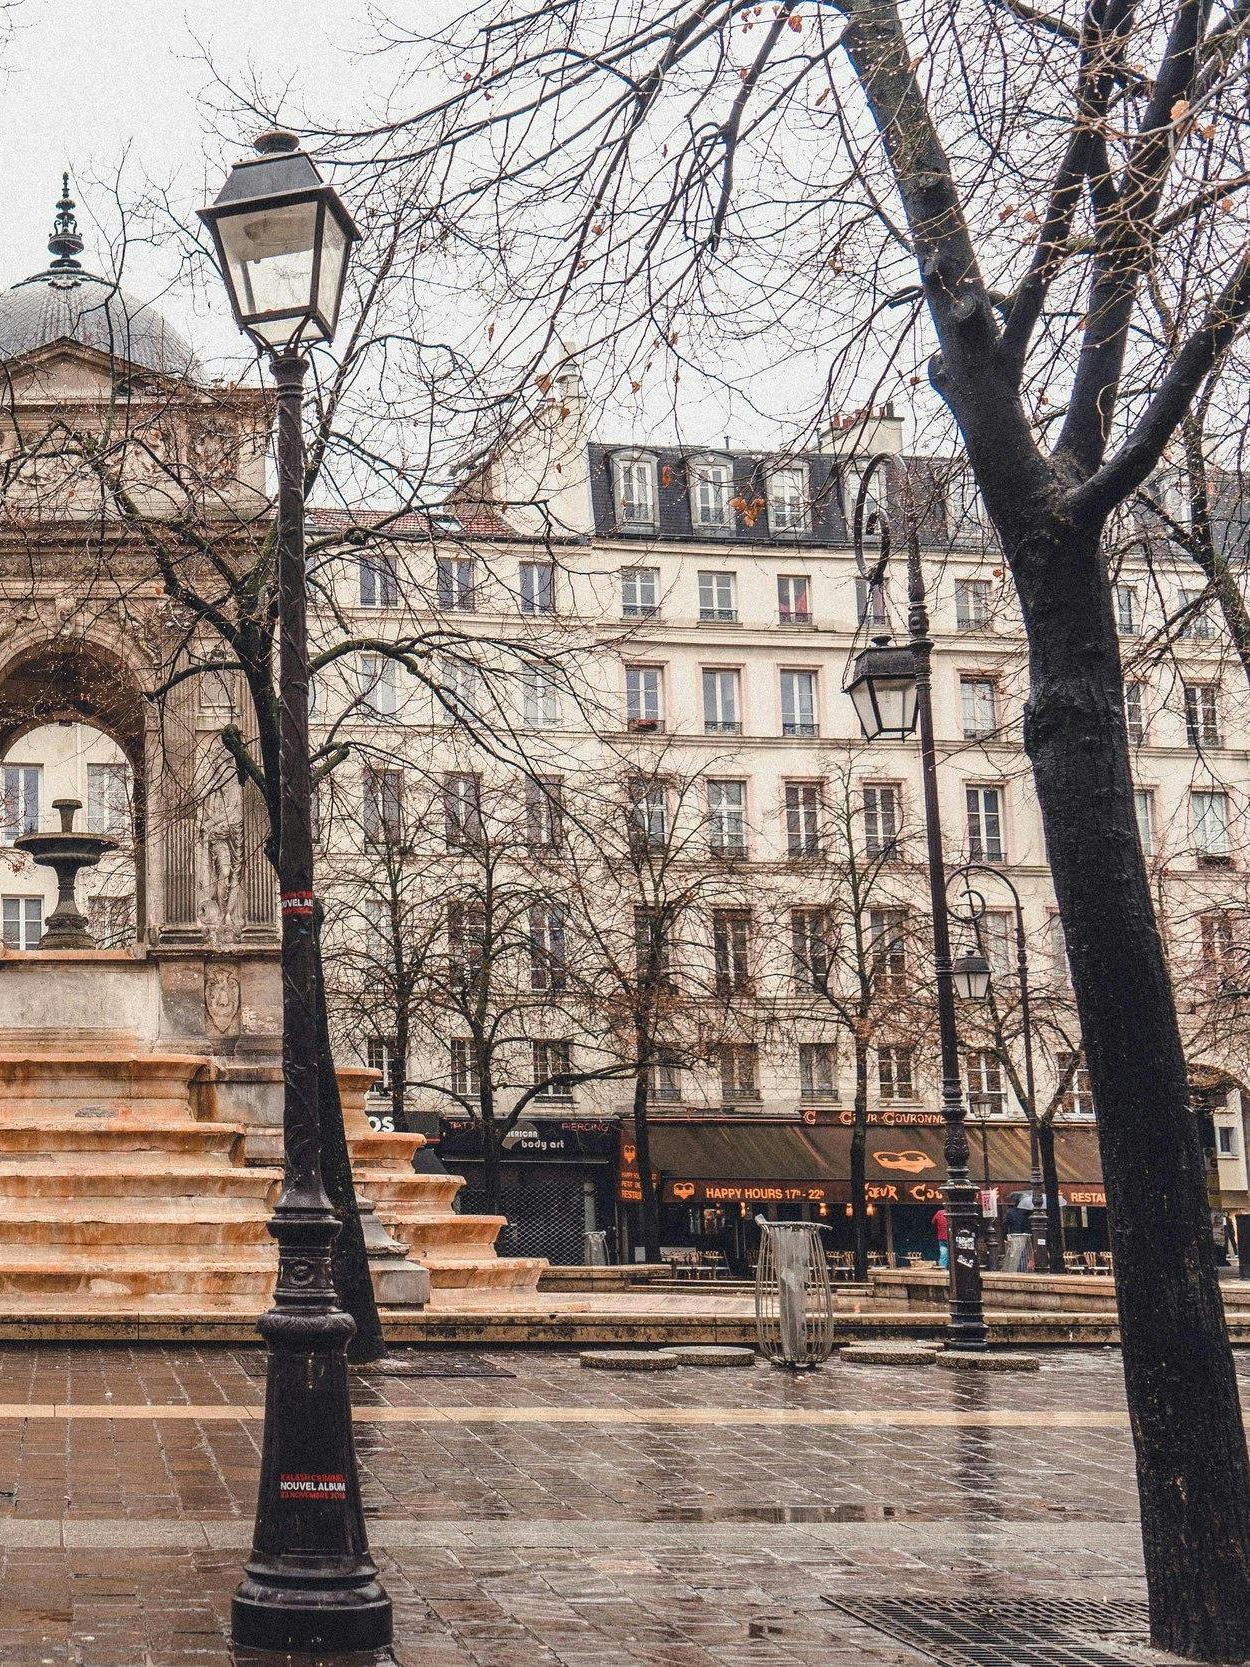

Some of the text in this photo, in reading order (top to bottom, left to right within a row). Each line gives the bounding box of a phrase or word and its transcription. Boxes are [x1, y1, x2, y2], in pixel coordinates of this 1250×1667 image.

[561, 1122, 609, 1132] PIERCING
[521, 1140, 565, 1150] body art
[706, 1188, 742, 1199] HAPPY
[746, 1188, 783, 1199] HOURS
[280, 1481, 346, 1491] NOUVEL ALBUM
